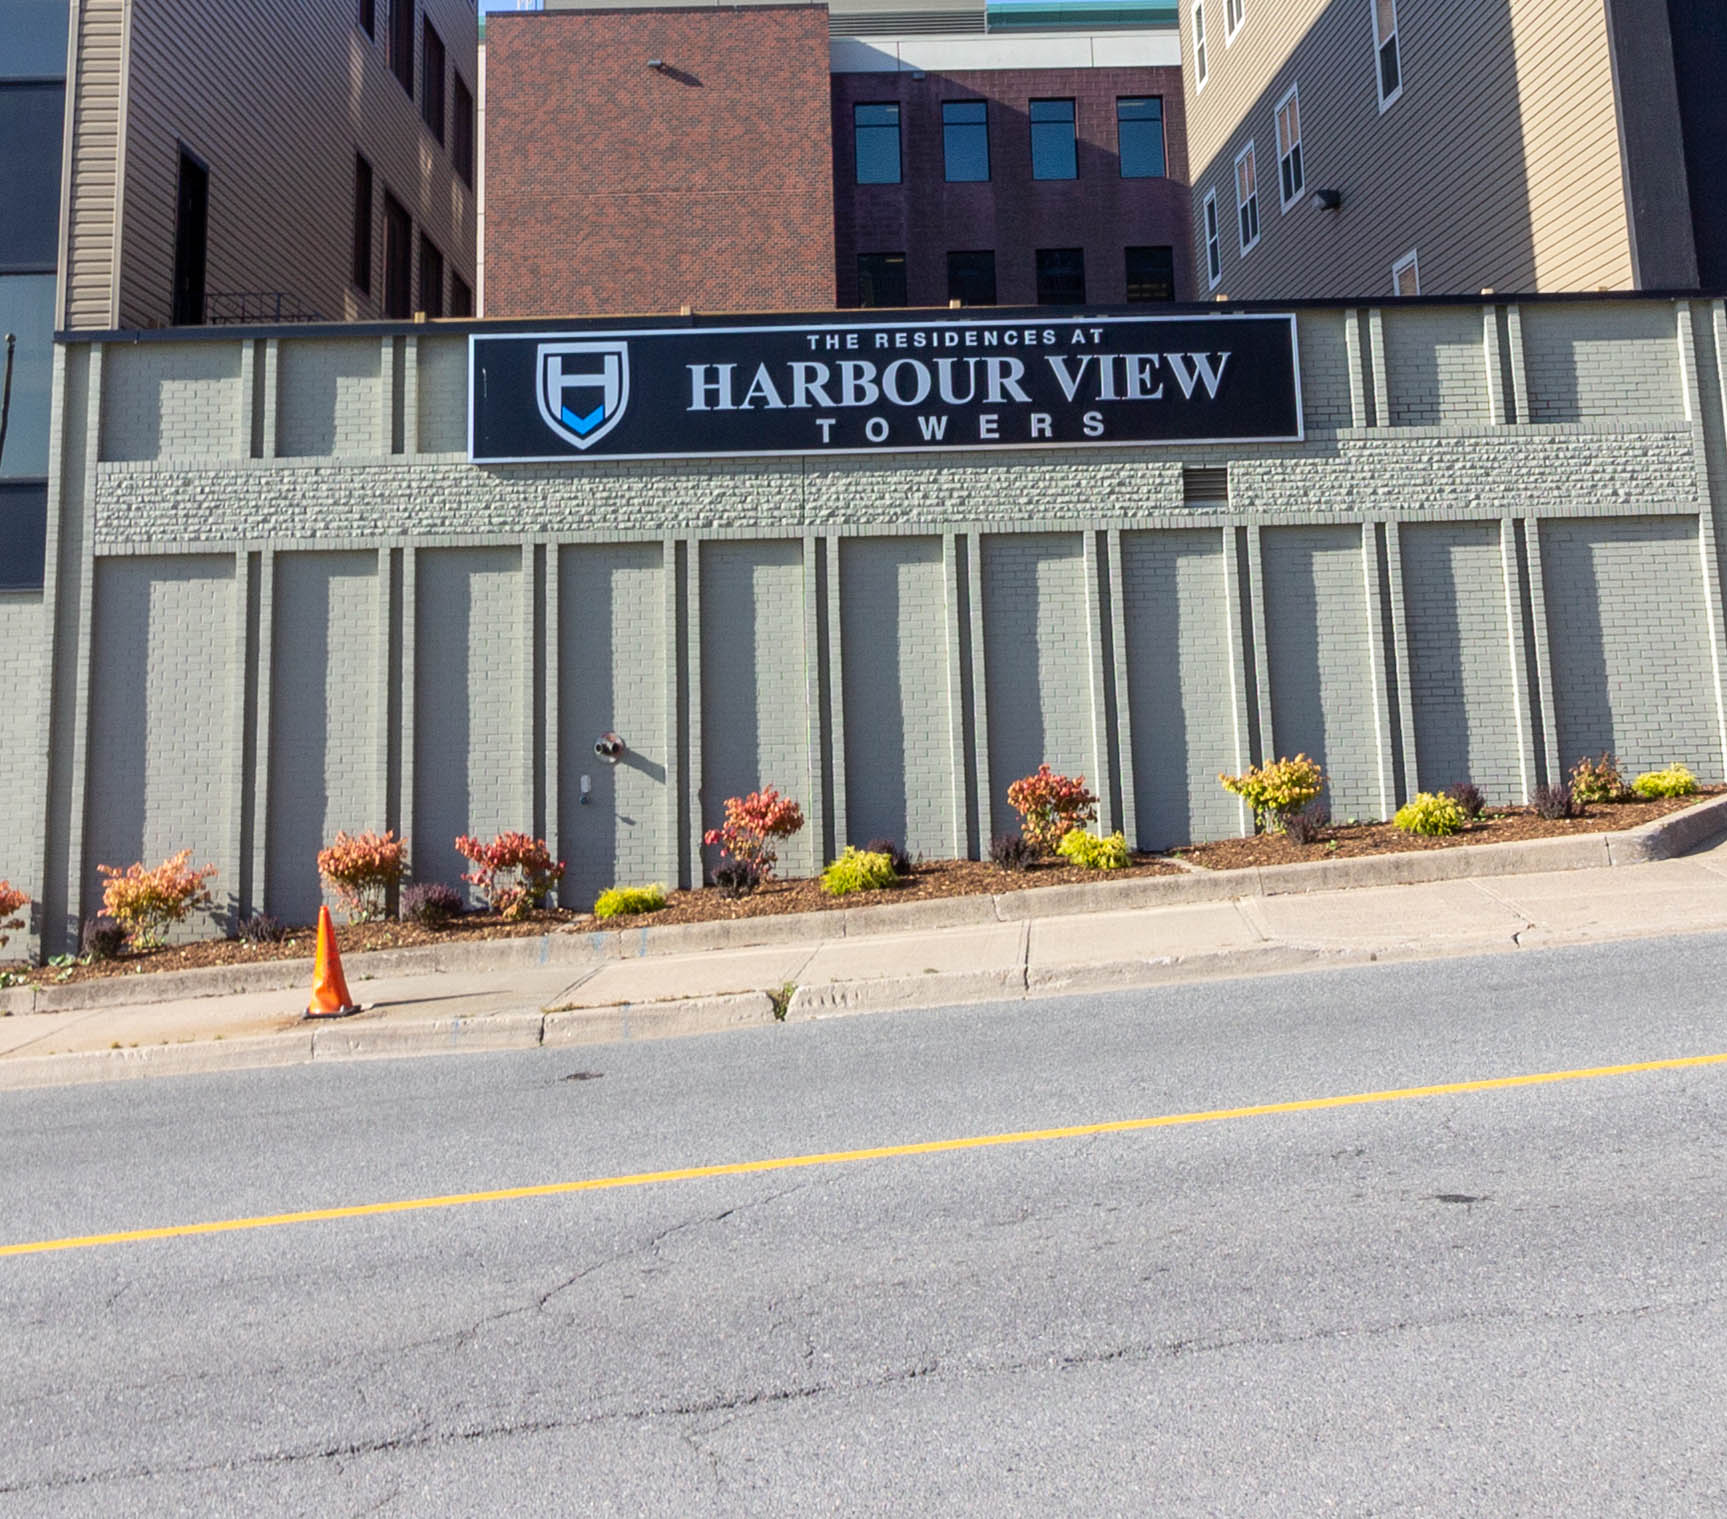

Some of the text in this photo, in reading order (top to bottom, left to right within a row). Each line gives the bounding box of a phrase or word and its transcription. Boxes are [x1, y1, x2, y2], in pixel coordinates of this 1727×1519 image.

[807, 328, 1104, 350] THE RESIDENCES AT
[685, 351, 1232, 411] HARBOUR VIEW
[815, 410, 1105, 444] TOWERS
